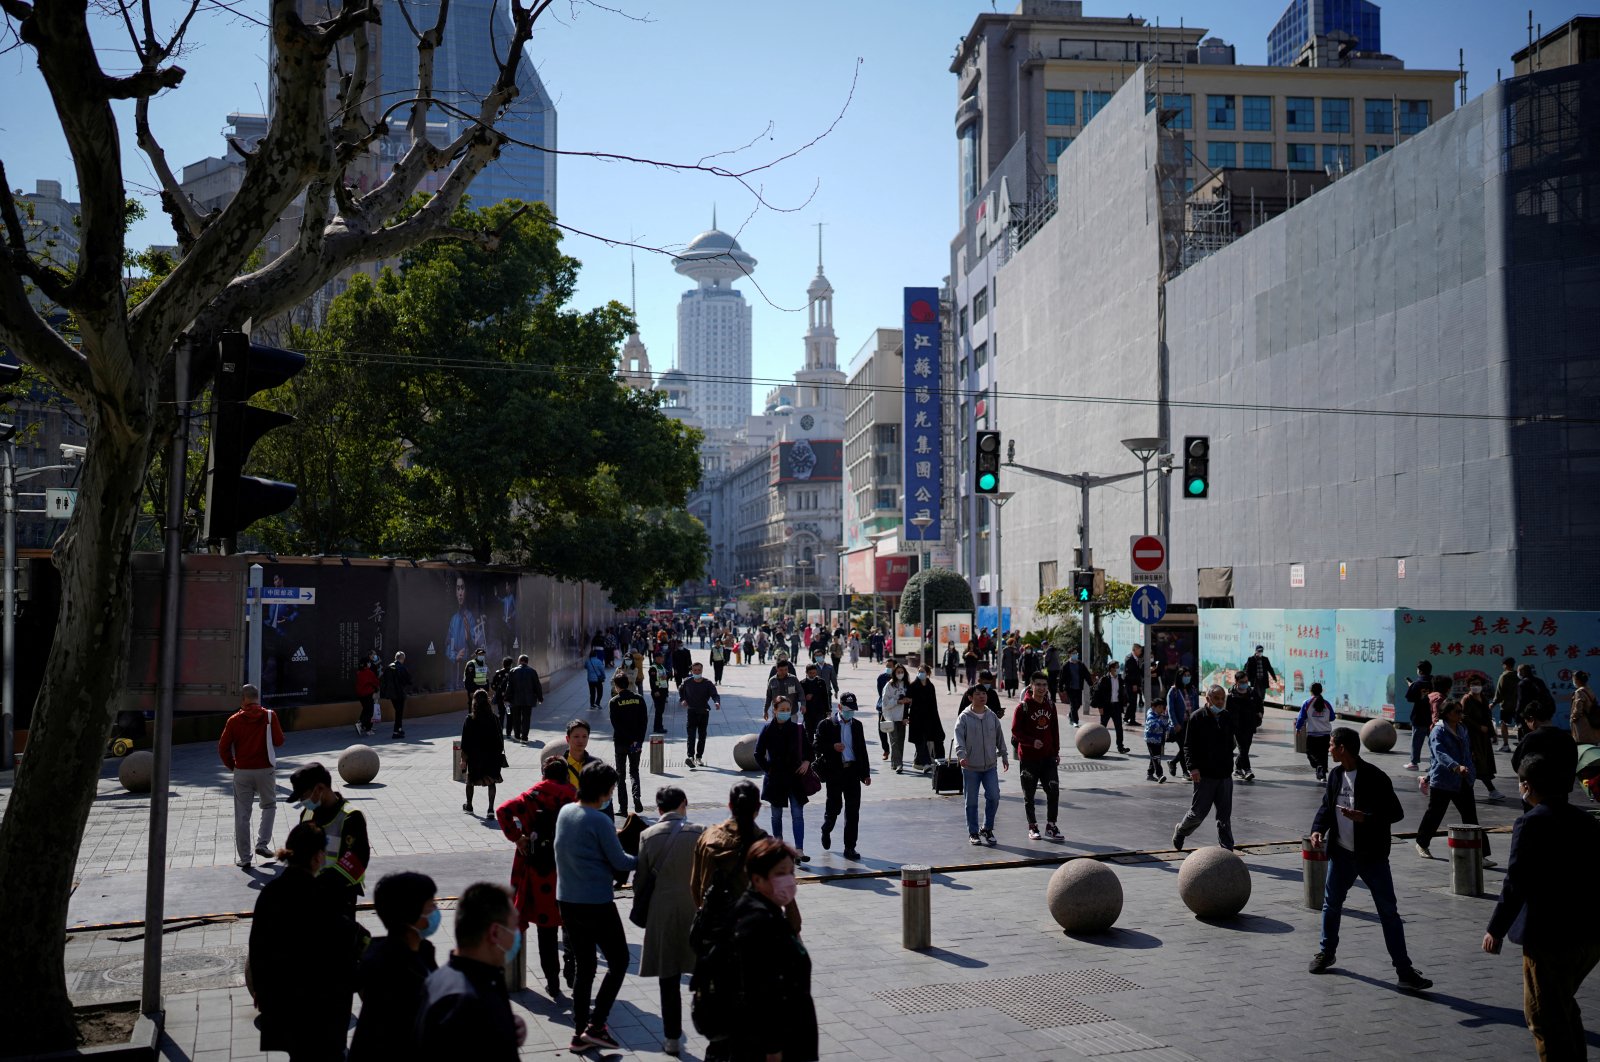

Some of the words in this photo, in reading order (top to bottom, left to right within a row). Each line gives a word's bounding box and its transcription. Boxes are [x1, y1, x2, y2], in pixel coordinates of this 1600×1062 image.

[975, 175, 1011, 258] FILA
[1469, 615, 1558, 637] 真老大房
[1361, 638, 1385, 663] 志愿者
[1429, 642, 1505, 656] 装修期间
[1522, 643, 1600, 659] 正常营业
